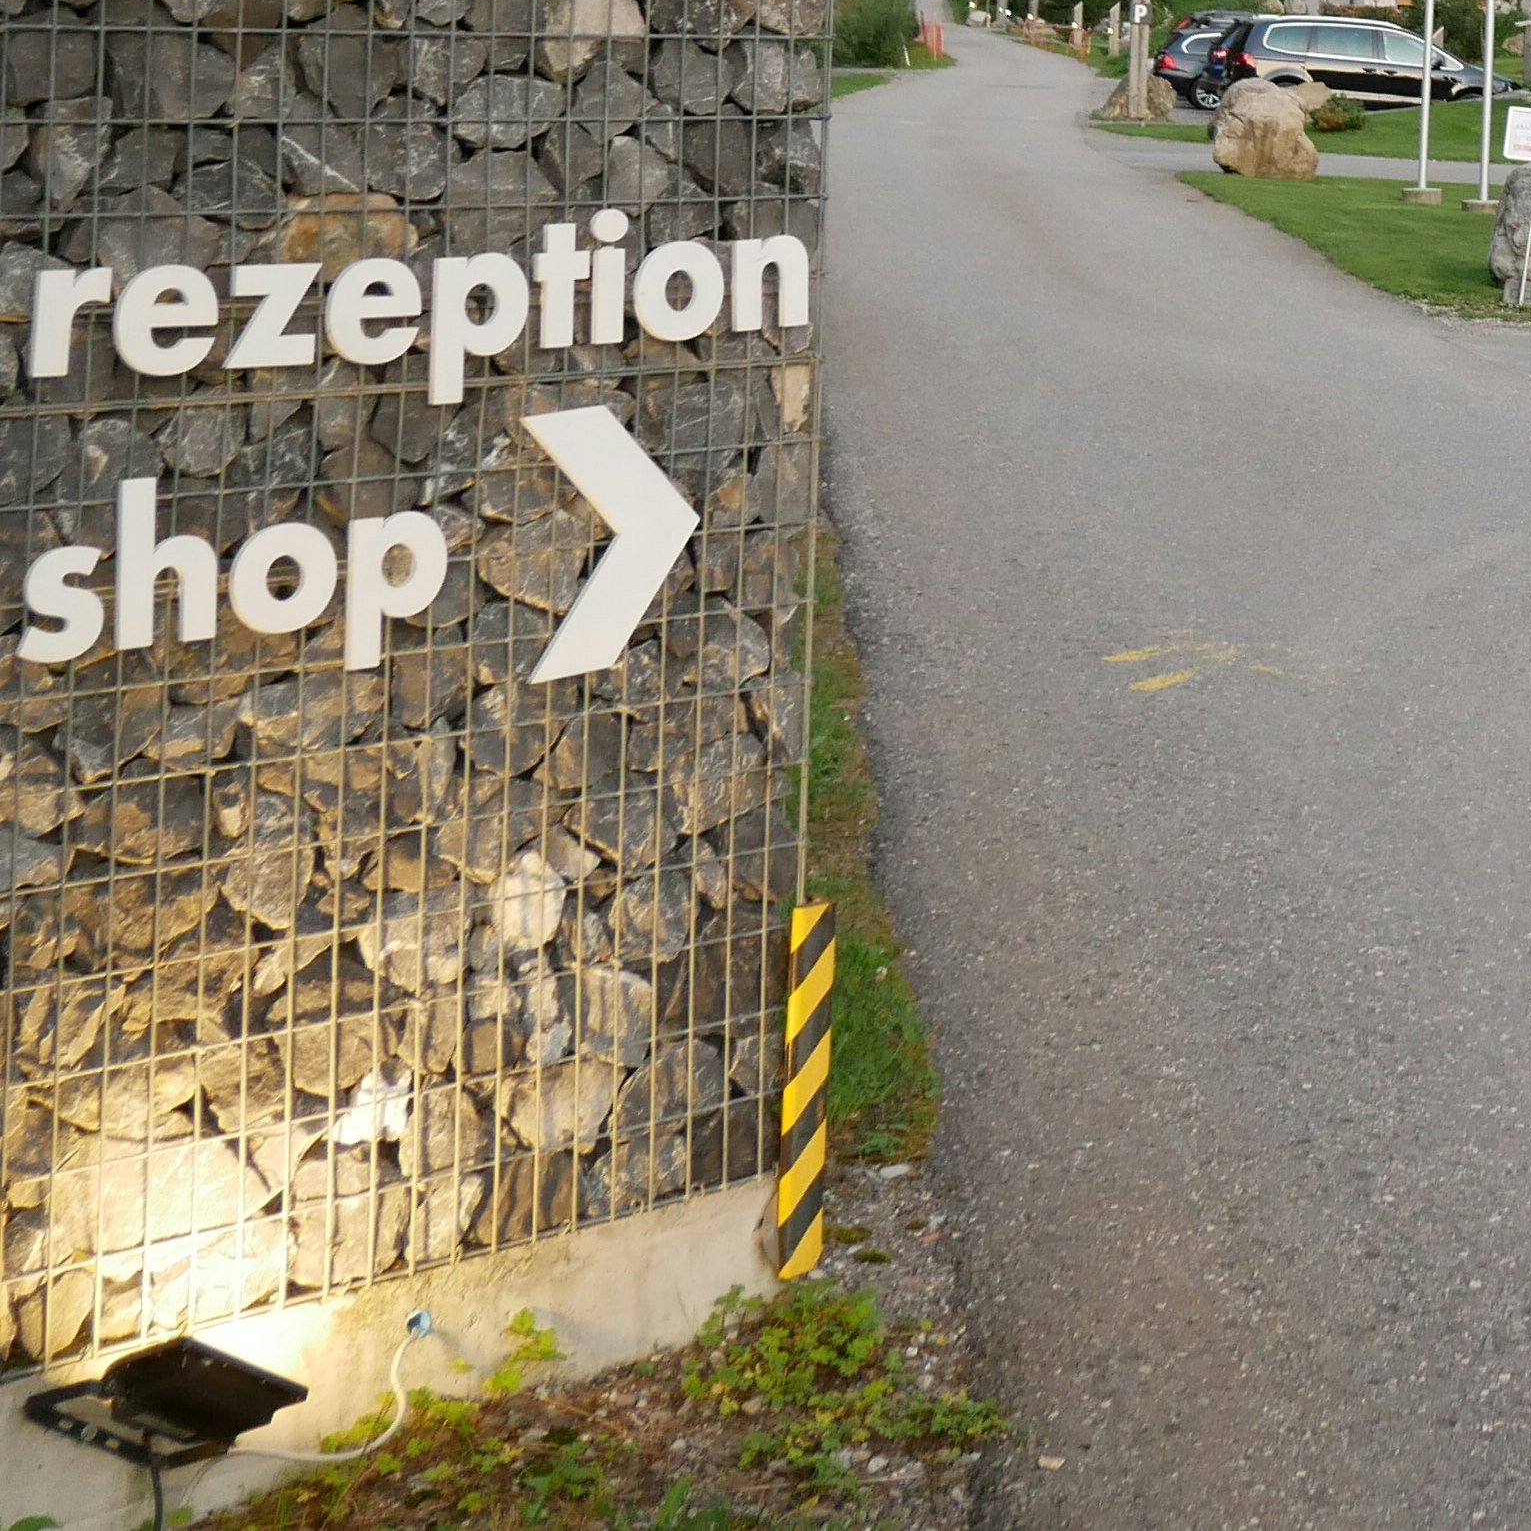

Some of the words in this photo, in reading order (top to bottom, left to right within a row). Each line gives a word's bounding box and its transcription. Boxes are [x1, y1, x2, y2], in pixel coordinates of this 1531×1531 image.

[1134, 4, 1147, 23] P
[30, 208, 810, 406] rezeption
[15, 477, 448, 671] shop
